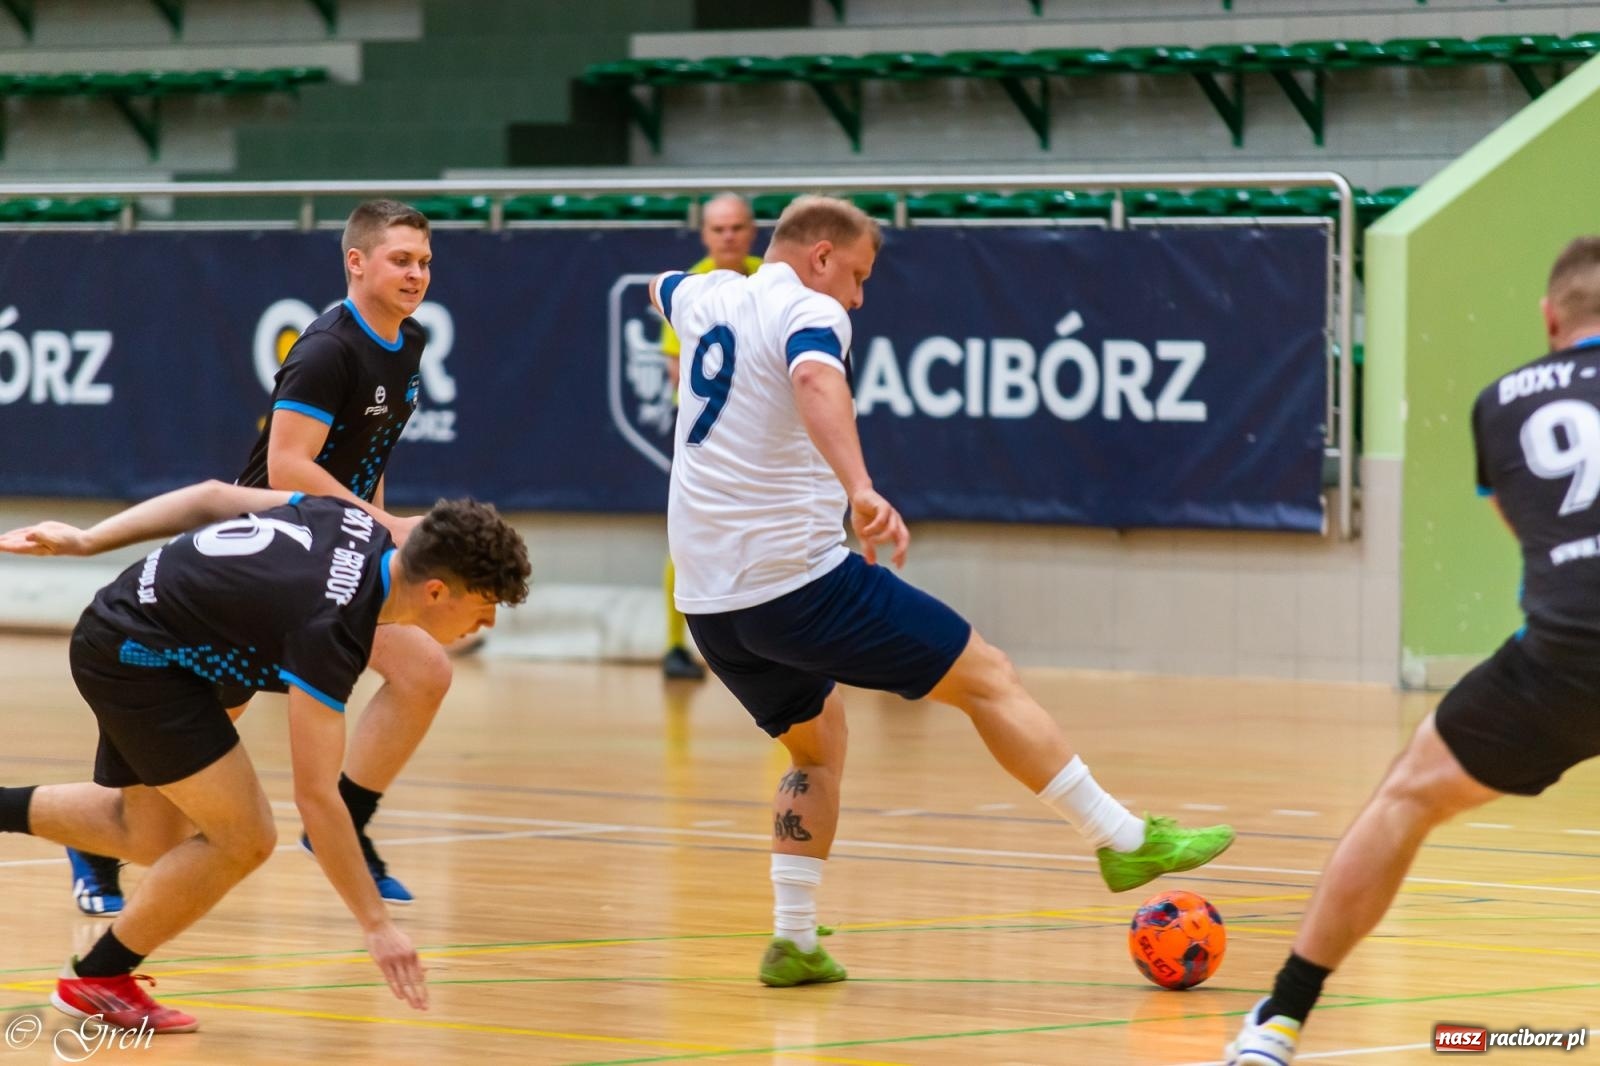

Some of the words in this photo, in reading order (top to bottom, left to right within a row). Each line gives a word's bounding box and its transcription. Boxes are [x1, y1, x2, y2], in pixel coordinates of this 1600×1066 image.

[686, 321, 737, 448] 9
[850, 310, 1207, 421] ACIBÓRZ
[1499, 360, 1576, 405] BOXY
[1519, 398, 1600, 517] 9
[192, 512, 314, 557] 6
[1138, 935, 1177, 979] SELECT
